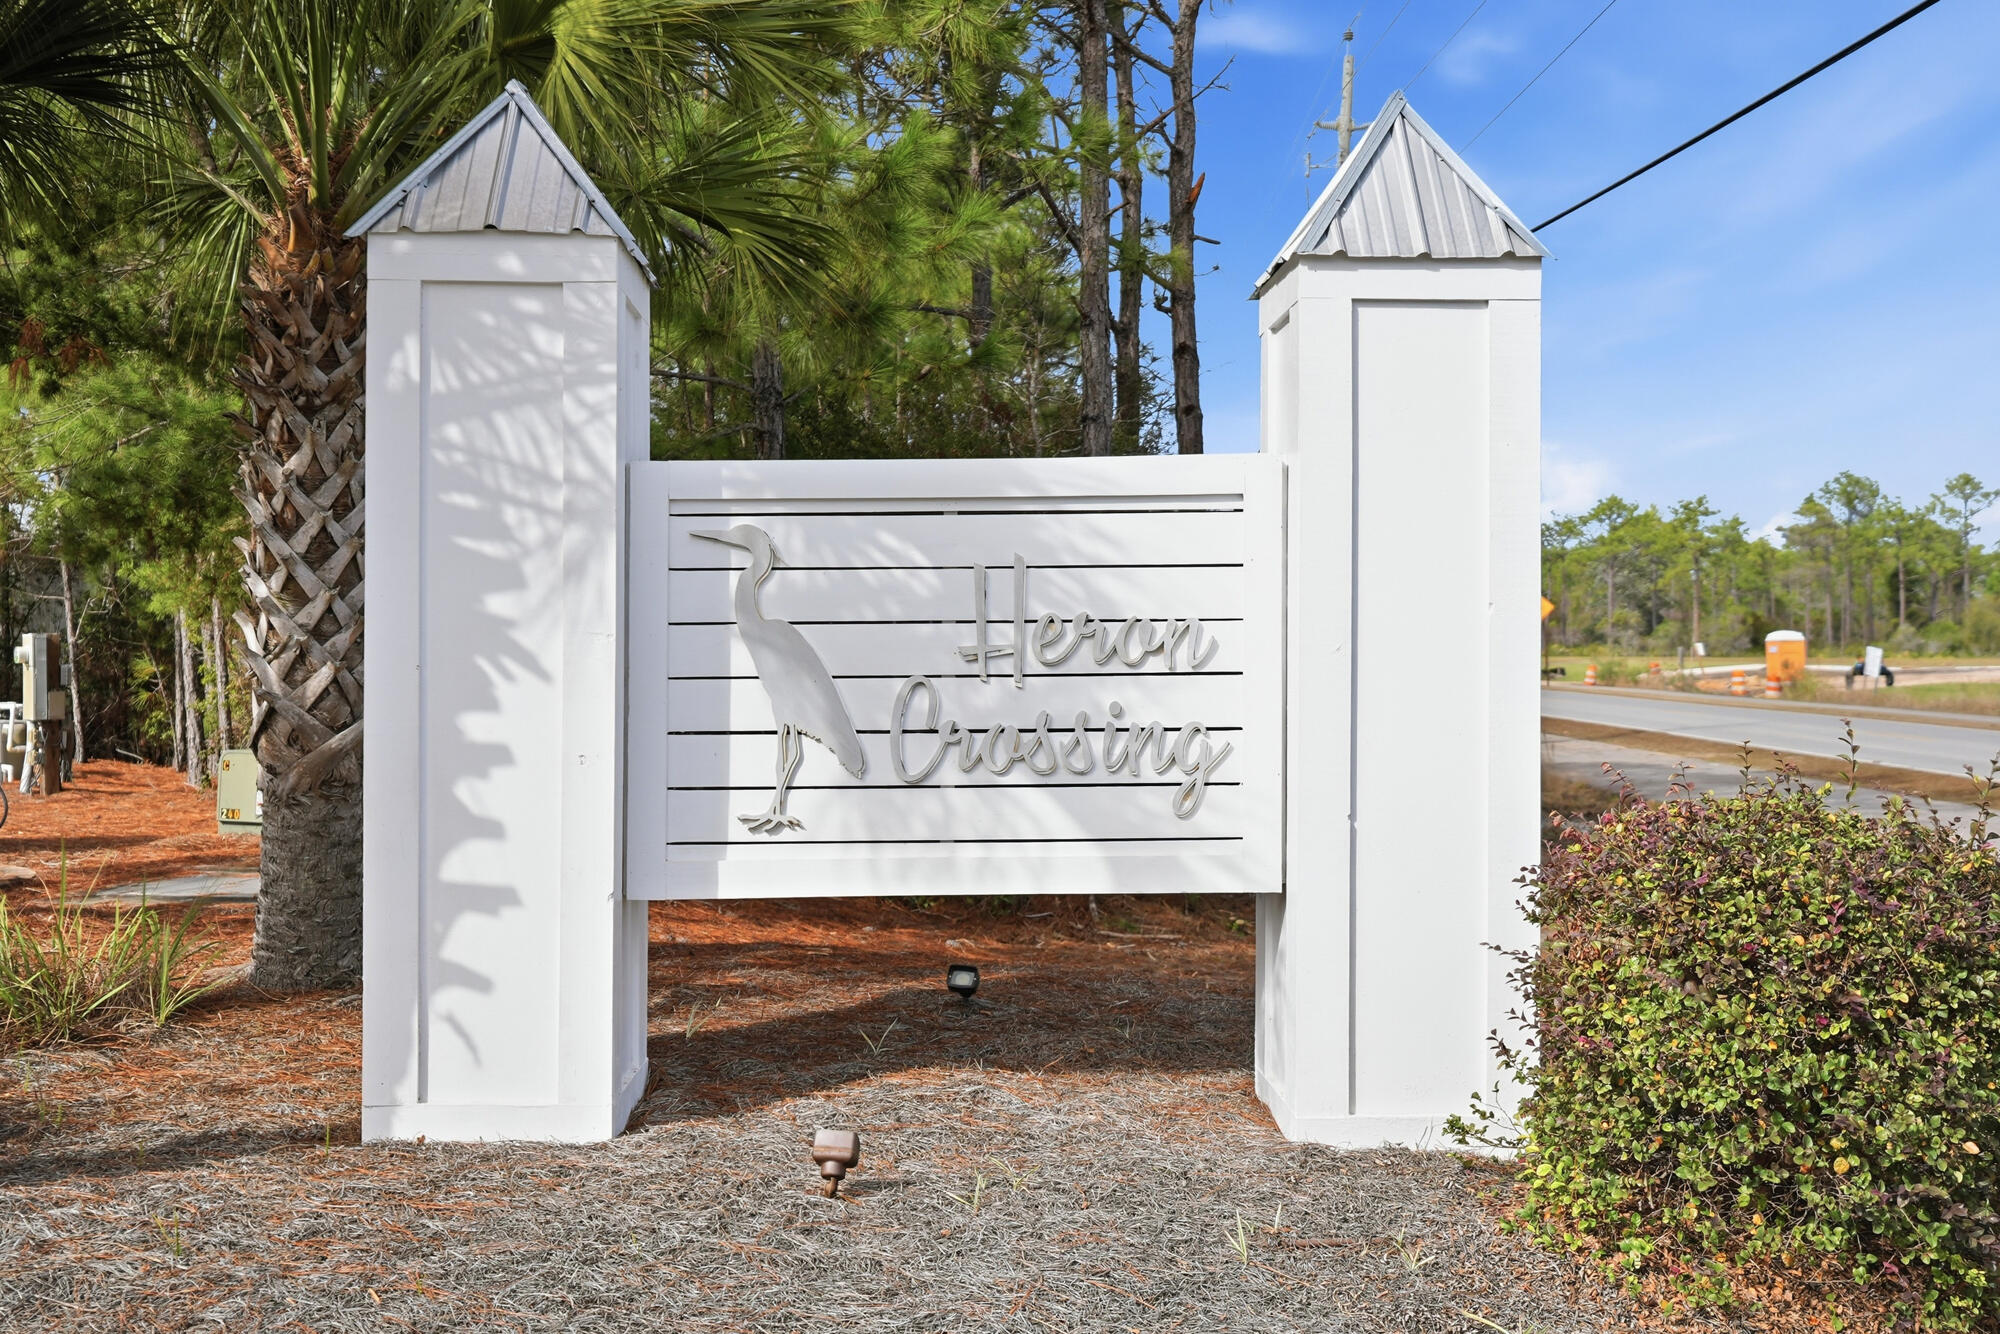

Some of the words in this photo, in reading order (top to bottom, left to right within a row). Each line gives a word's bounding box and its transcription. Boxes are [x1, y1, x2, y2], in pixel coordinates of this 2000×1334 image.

[957, 552, 1218, 688] Heron
[221, 808, 240, 819] 240
[890, 674, 1234, 818] Crossing
